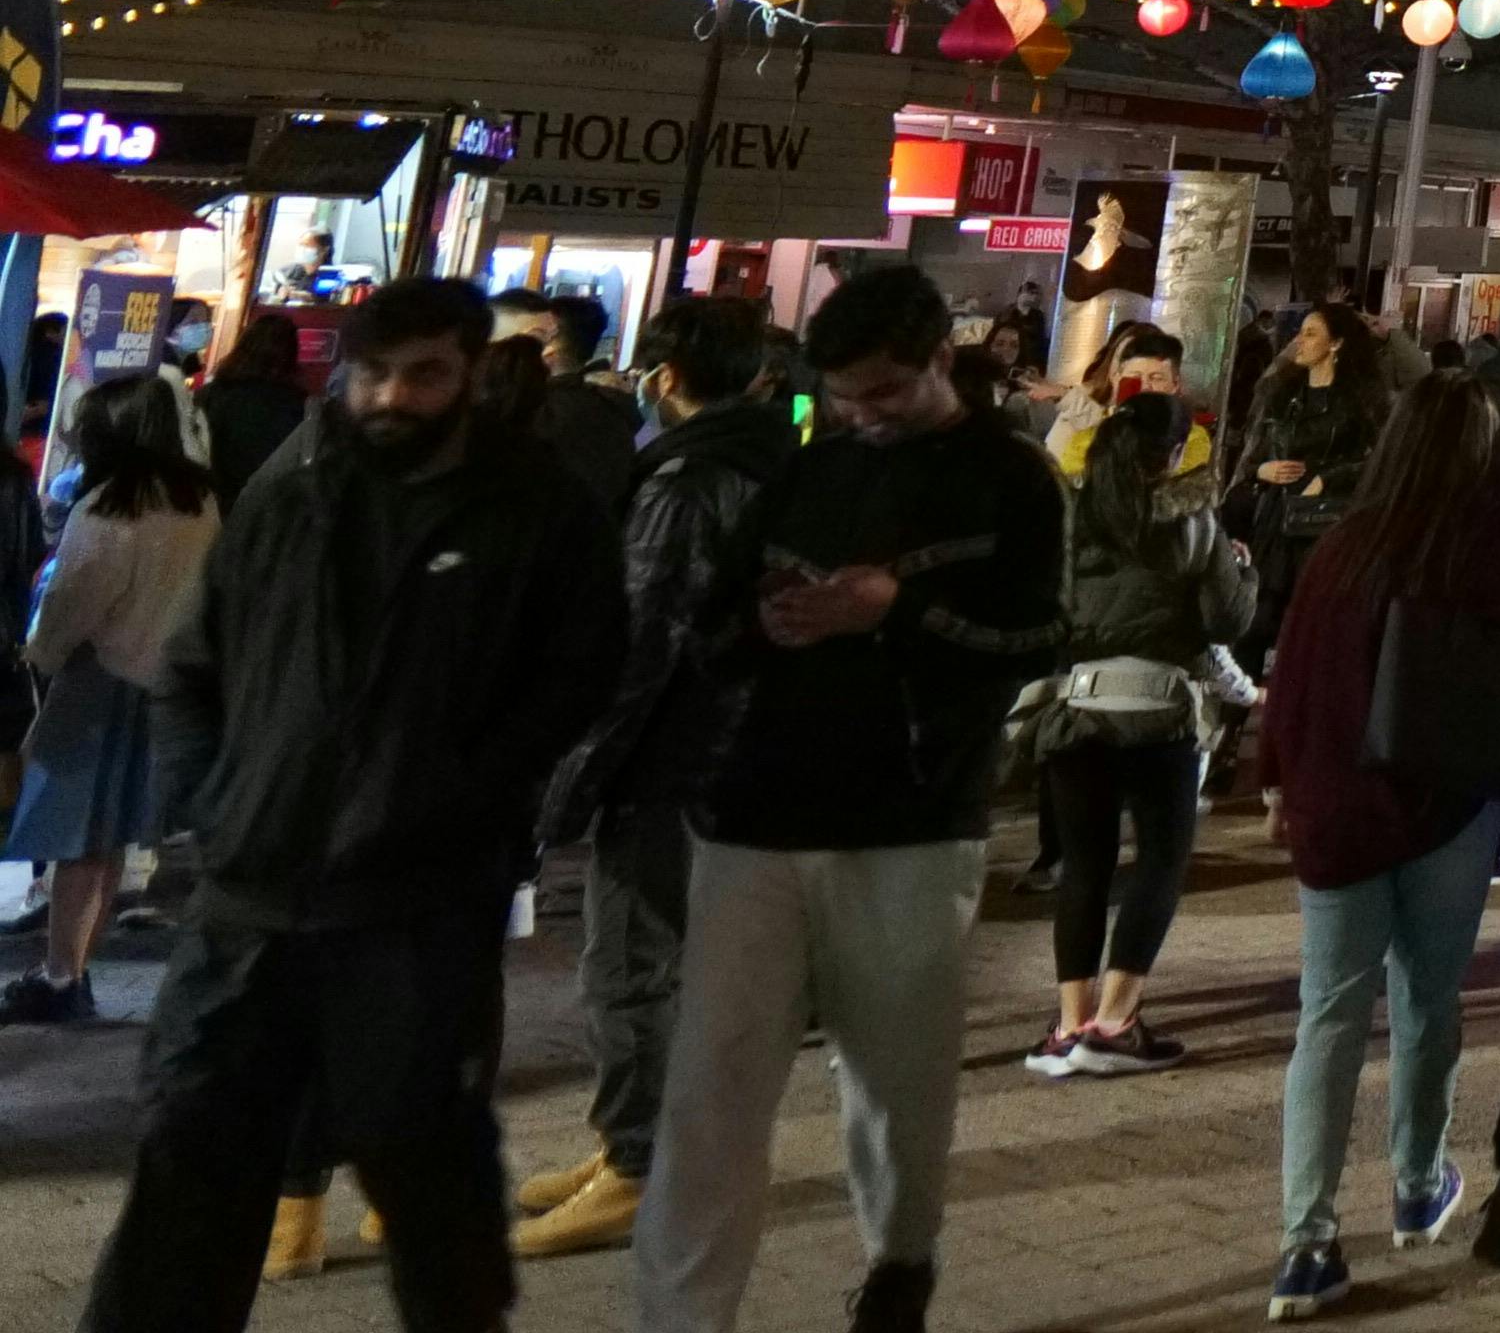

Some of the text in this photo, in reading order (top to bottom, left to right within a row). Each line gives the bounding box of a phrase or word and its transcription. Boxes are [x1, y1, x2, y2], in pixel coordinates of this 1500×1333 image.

[992, 225, 1068, 249] RED CROSS
[124, 291, 160, 334] FREE
